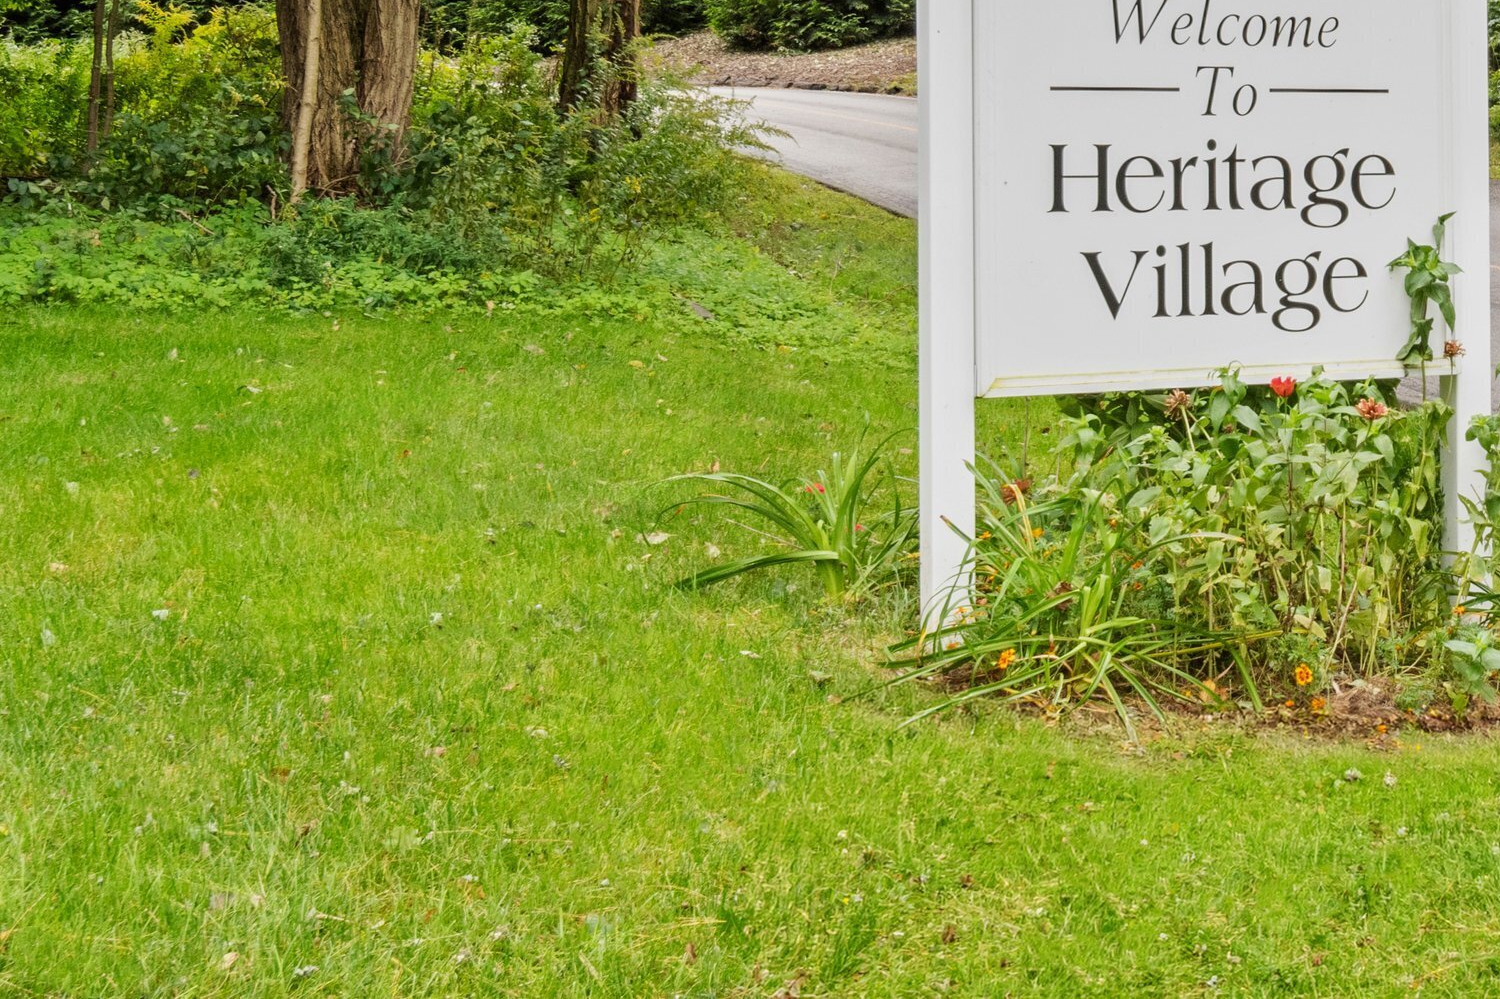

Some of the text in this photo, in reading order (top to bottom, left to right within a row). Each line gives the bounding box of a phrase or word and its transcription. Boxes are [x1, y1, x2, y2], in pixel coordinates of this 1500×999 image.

[1195, 65, 1258, 117] To
[1046, 138, 1396, 229] Heritage
[1079, 241, 1370, 333] Village
